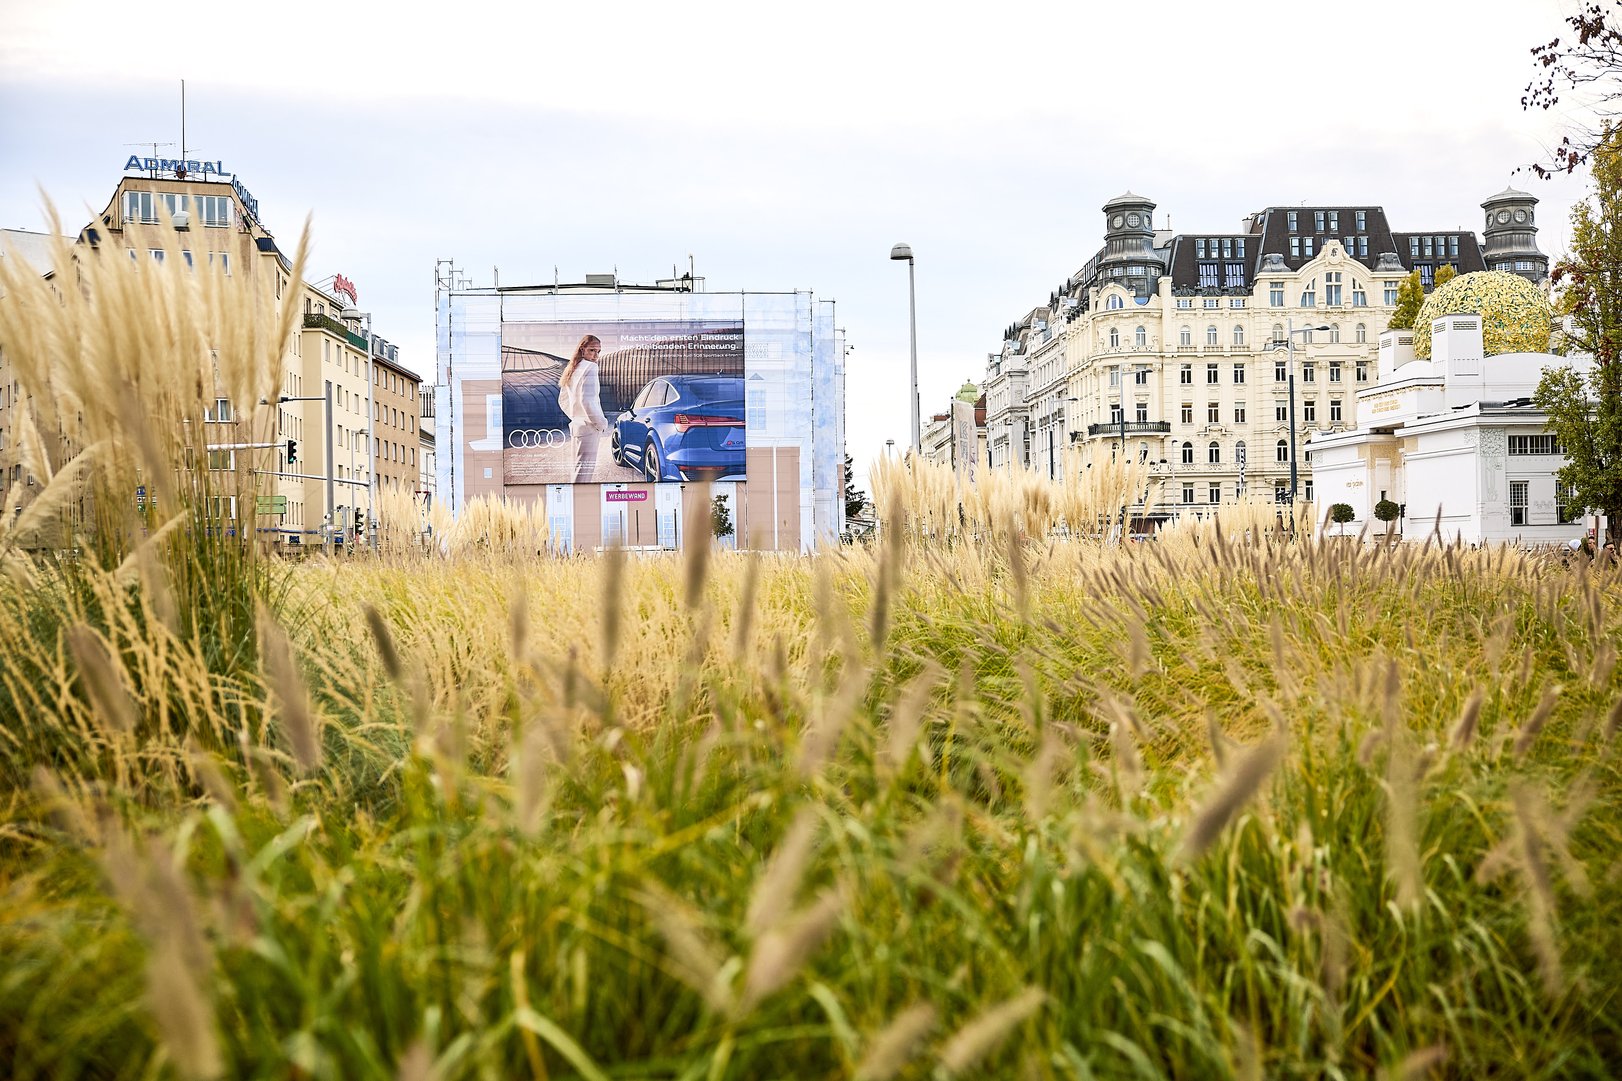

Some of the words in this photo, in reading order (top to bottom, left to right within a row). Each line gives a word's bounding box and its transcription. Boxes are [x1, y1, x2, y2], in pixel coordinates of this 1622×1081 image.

[123, 155, 231, 176] ADMIRAL
[620, 334, 649, 342] Macht
[701, 333, 739, 341] Eindruck
[688, 342, 739, 351] Erinnerung.
